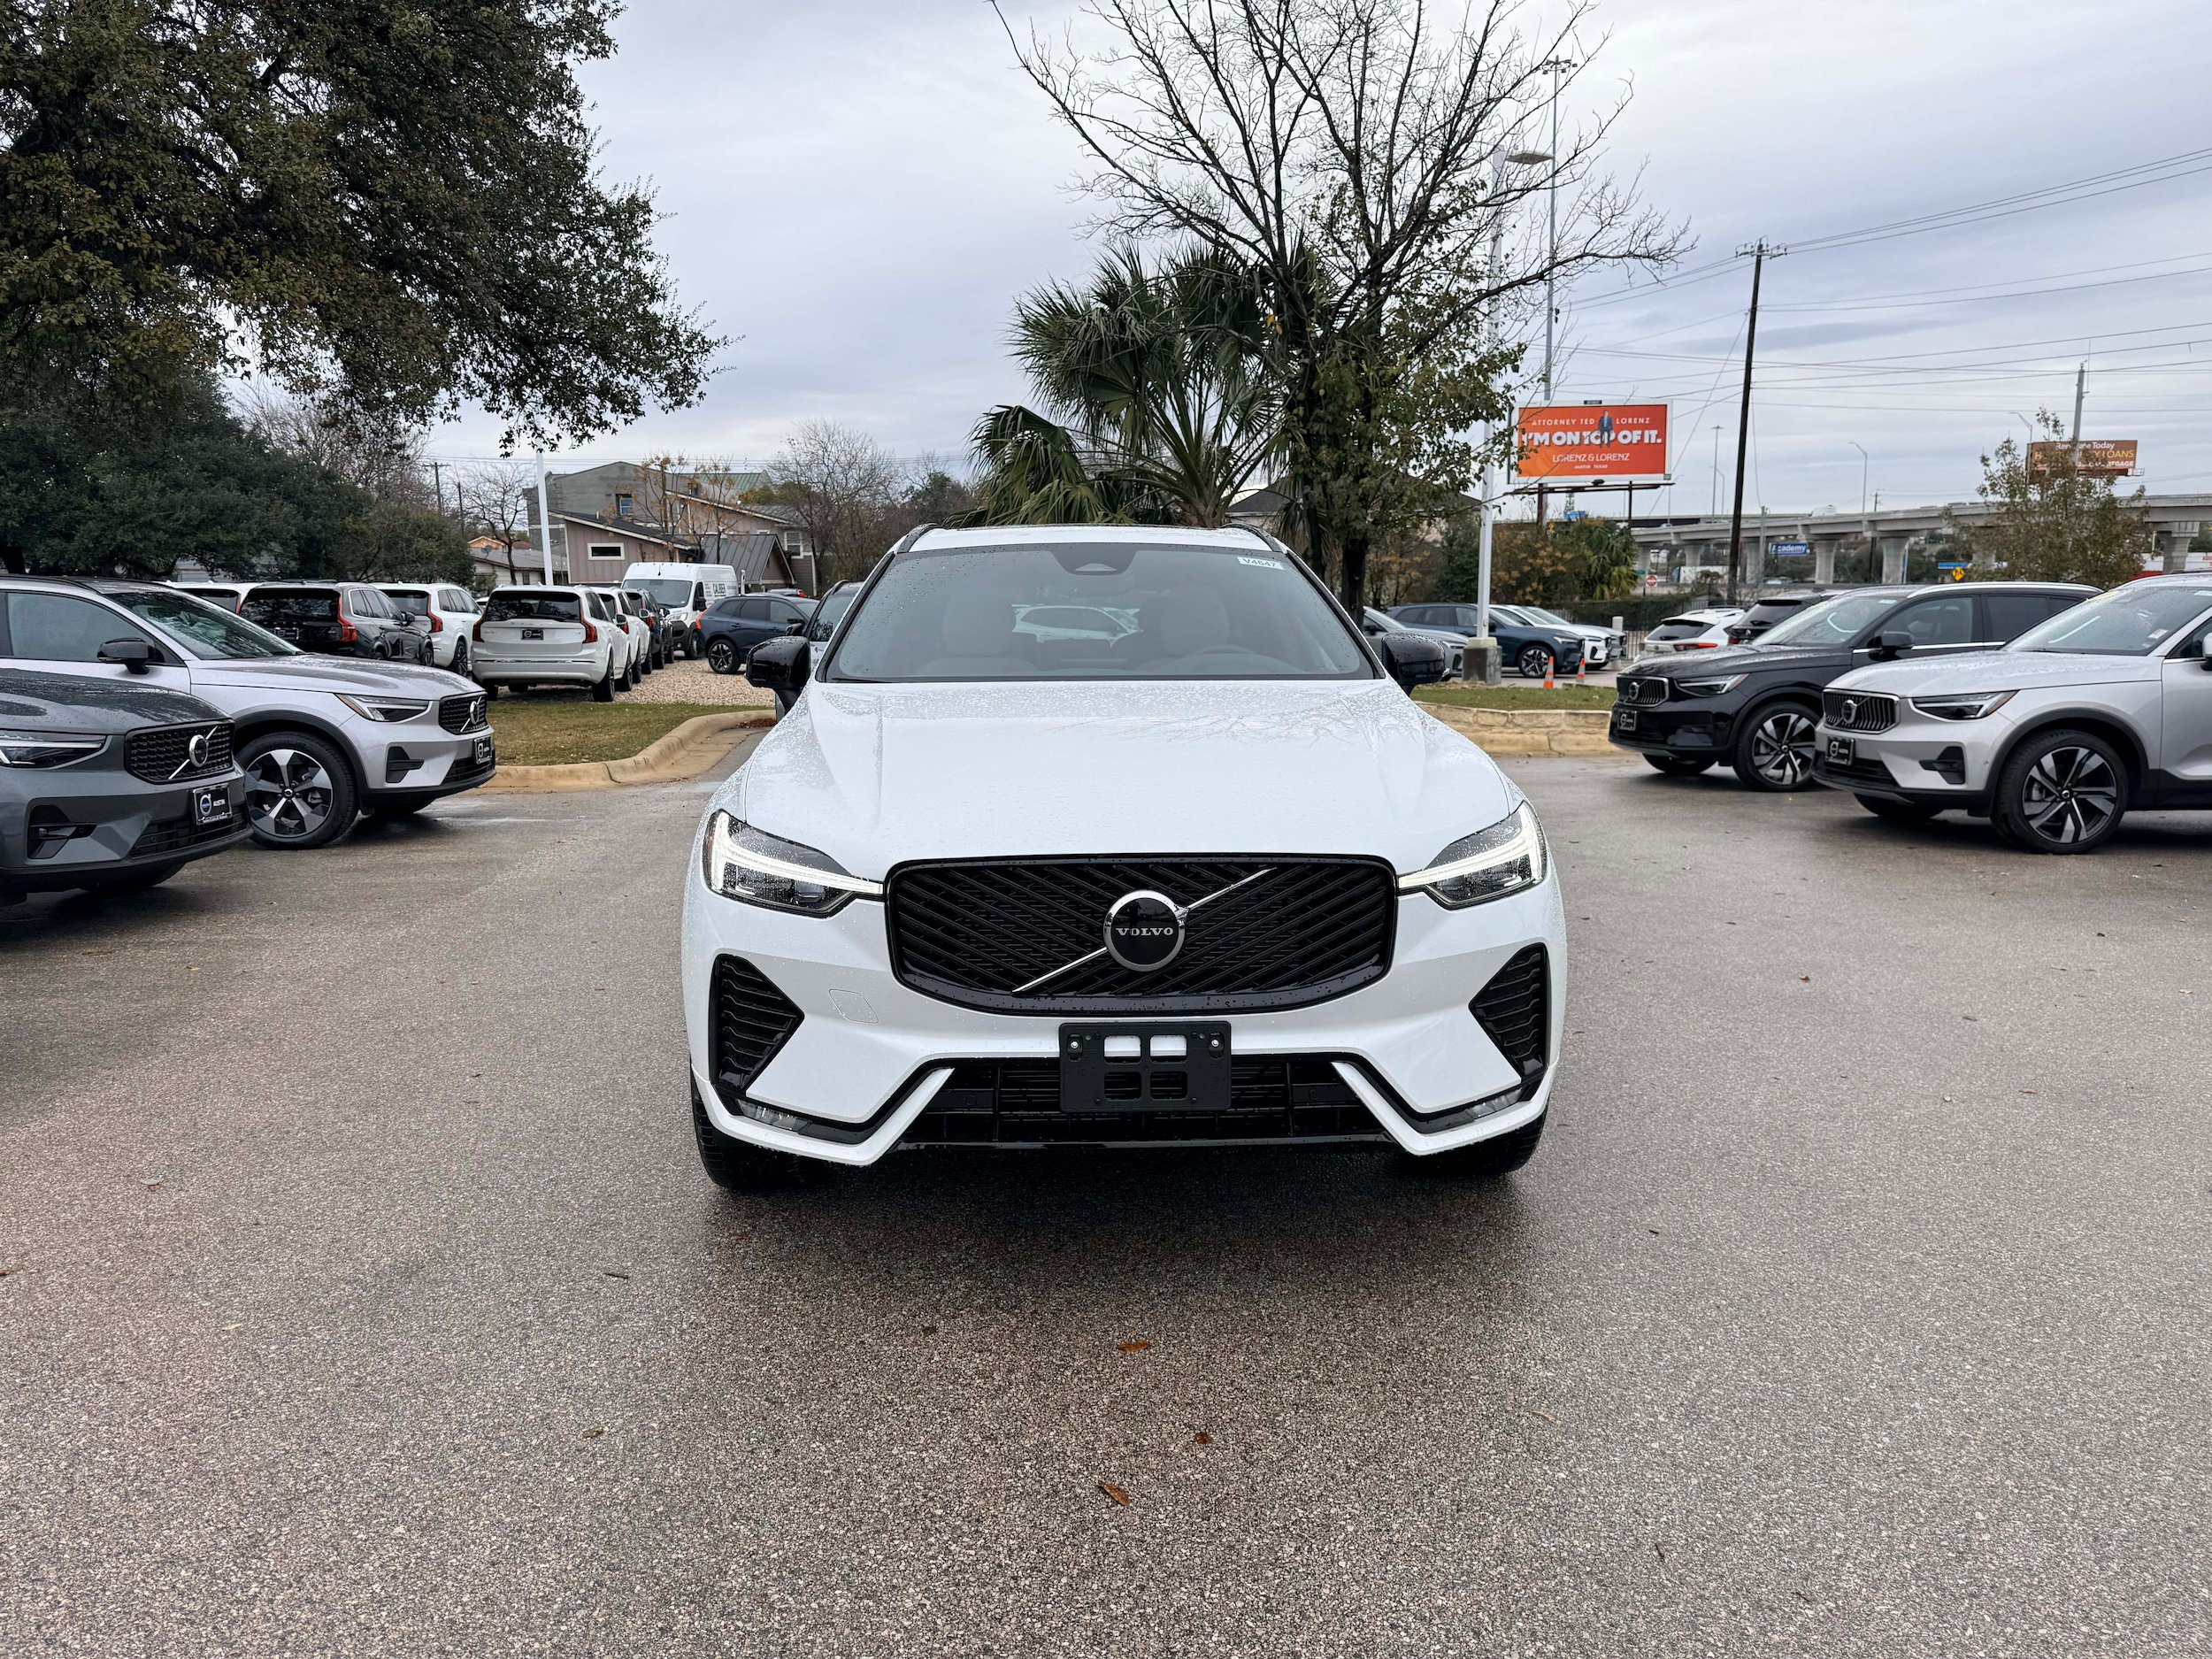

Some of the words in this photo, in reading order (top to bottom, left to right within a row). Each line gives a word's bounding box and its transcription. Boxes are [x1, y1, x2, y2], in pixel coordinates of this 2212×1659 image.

[1552, 432, 1579, 445] ON
[1617, 430, 1642, 444] OF
[1644, 430, 1663, 443] IT.
[1595, 453, 1630, 462] LORENZ
[1771, 544, 1806, 553] Academy
[1242, 558, 1276, 567] V4647
[1116, 927, 1173, 936] VOLVO
